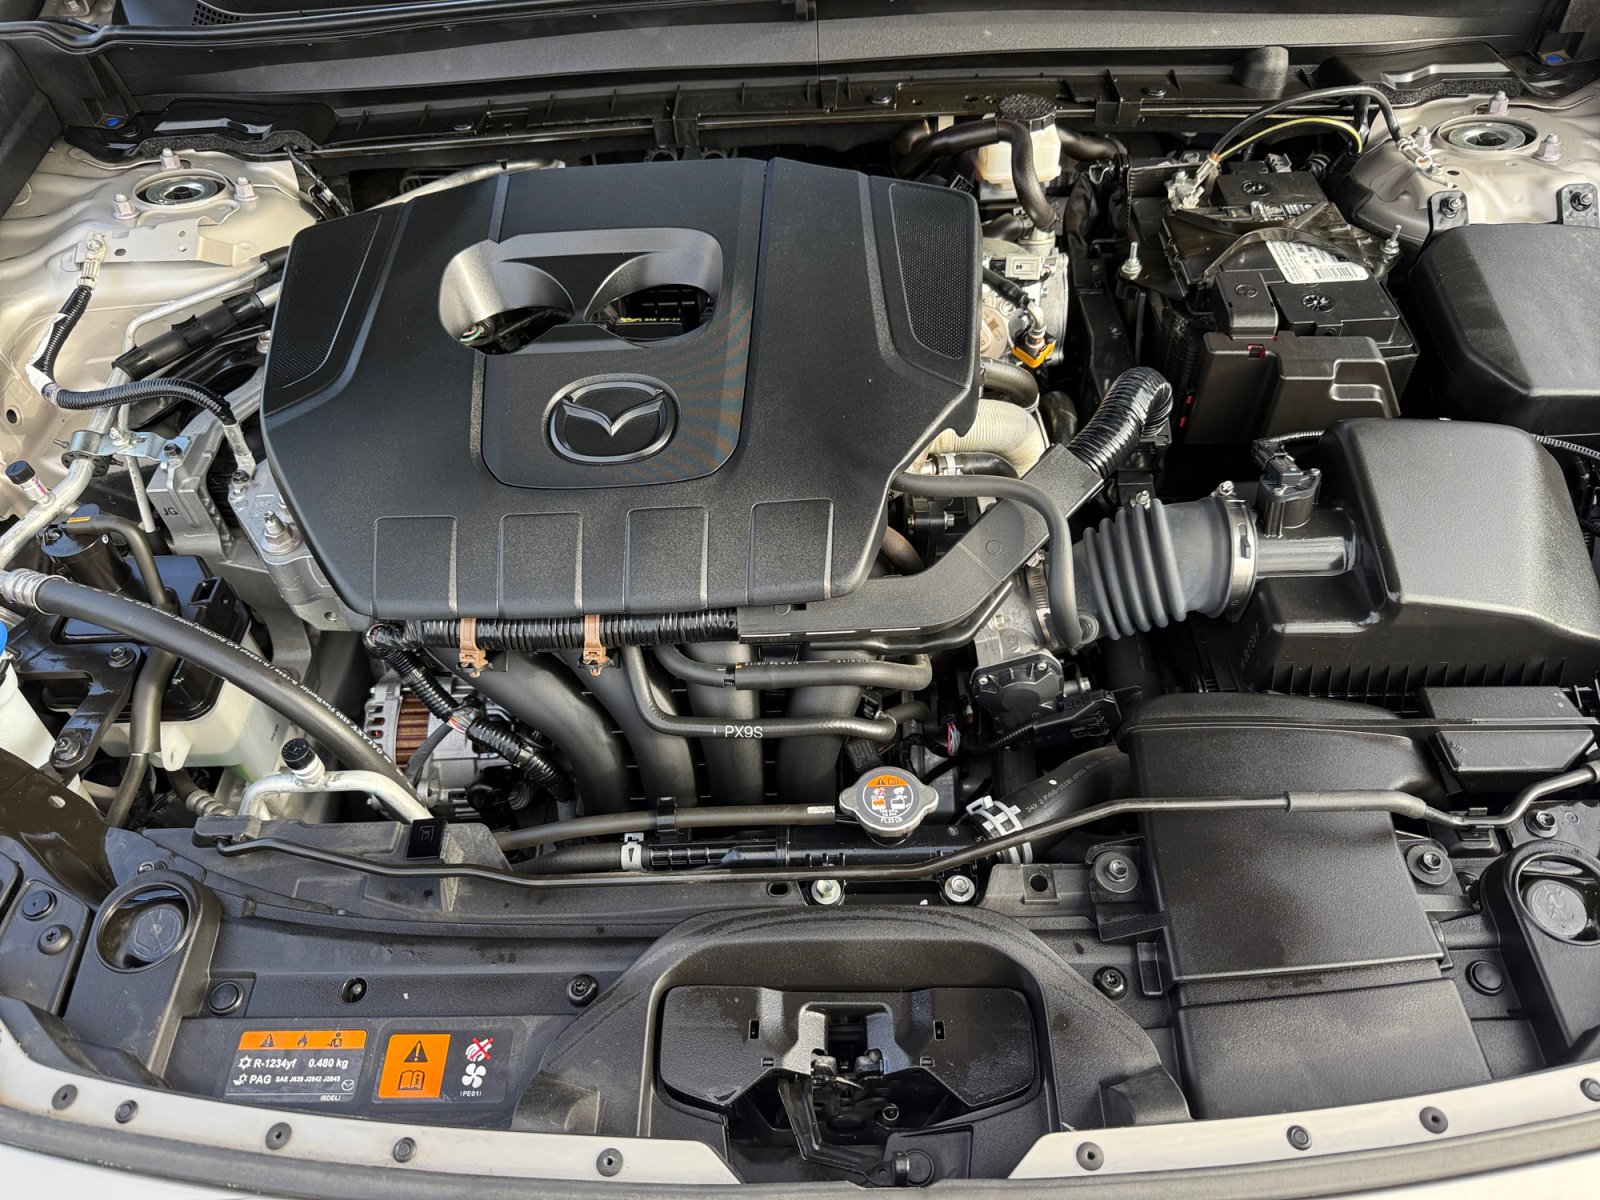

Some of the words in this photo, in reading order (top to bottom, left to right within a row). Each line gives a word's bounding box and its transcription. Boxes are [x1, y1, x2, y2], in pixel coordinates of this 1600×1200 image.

[724, 725, 763, 738] PX9S
[350, 725, 383, 754] GALAXY
[253, 1058, 298, 1070] R-1234yf
[308, 1058, 335, 1068] 0.480
[335, 1058, 349, 1070] kg
[249, 1074, 272, 1085] PAG
[275, 1075, 289, 1083] SAE
